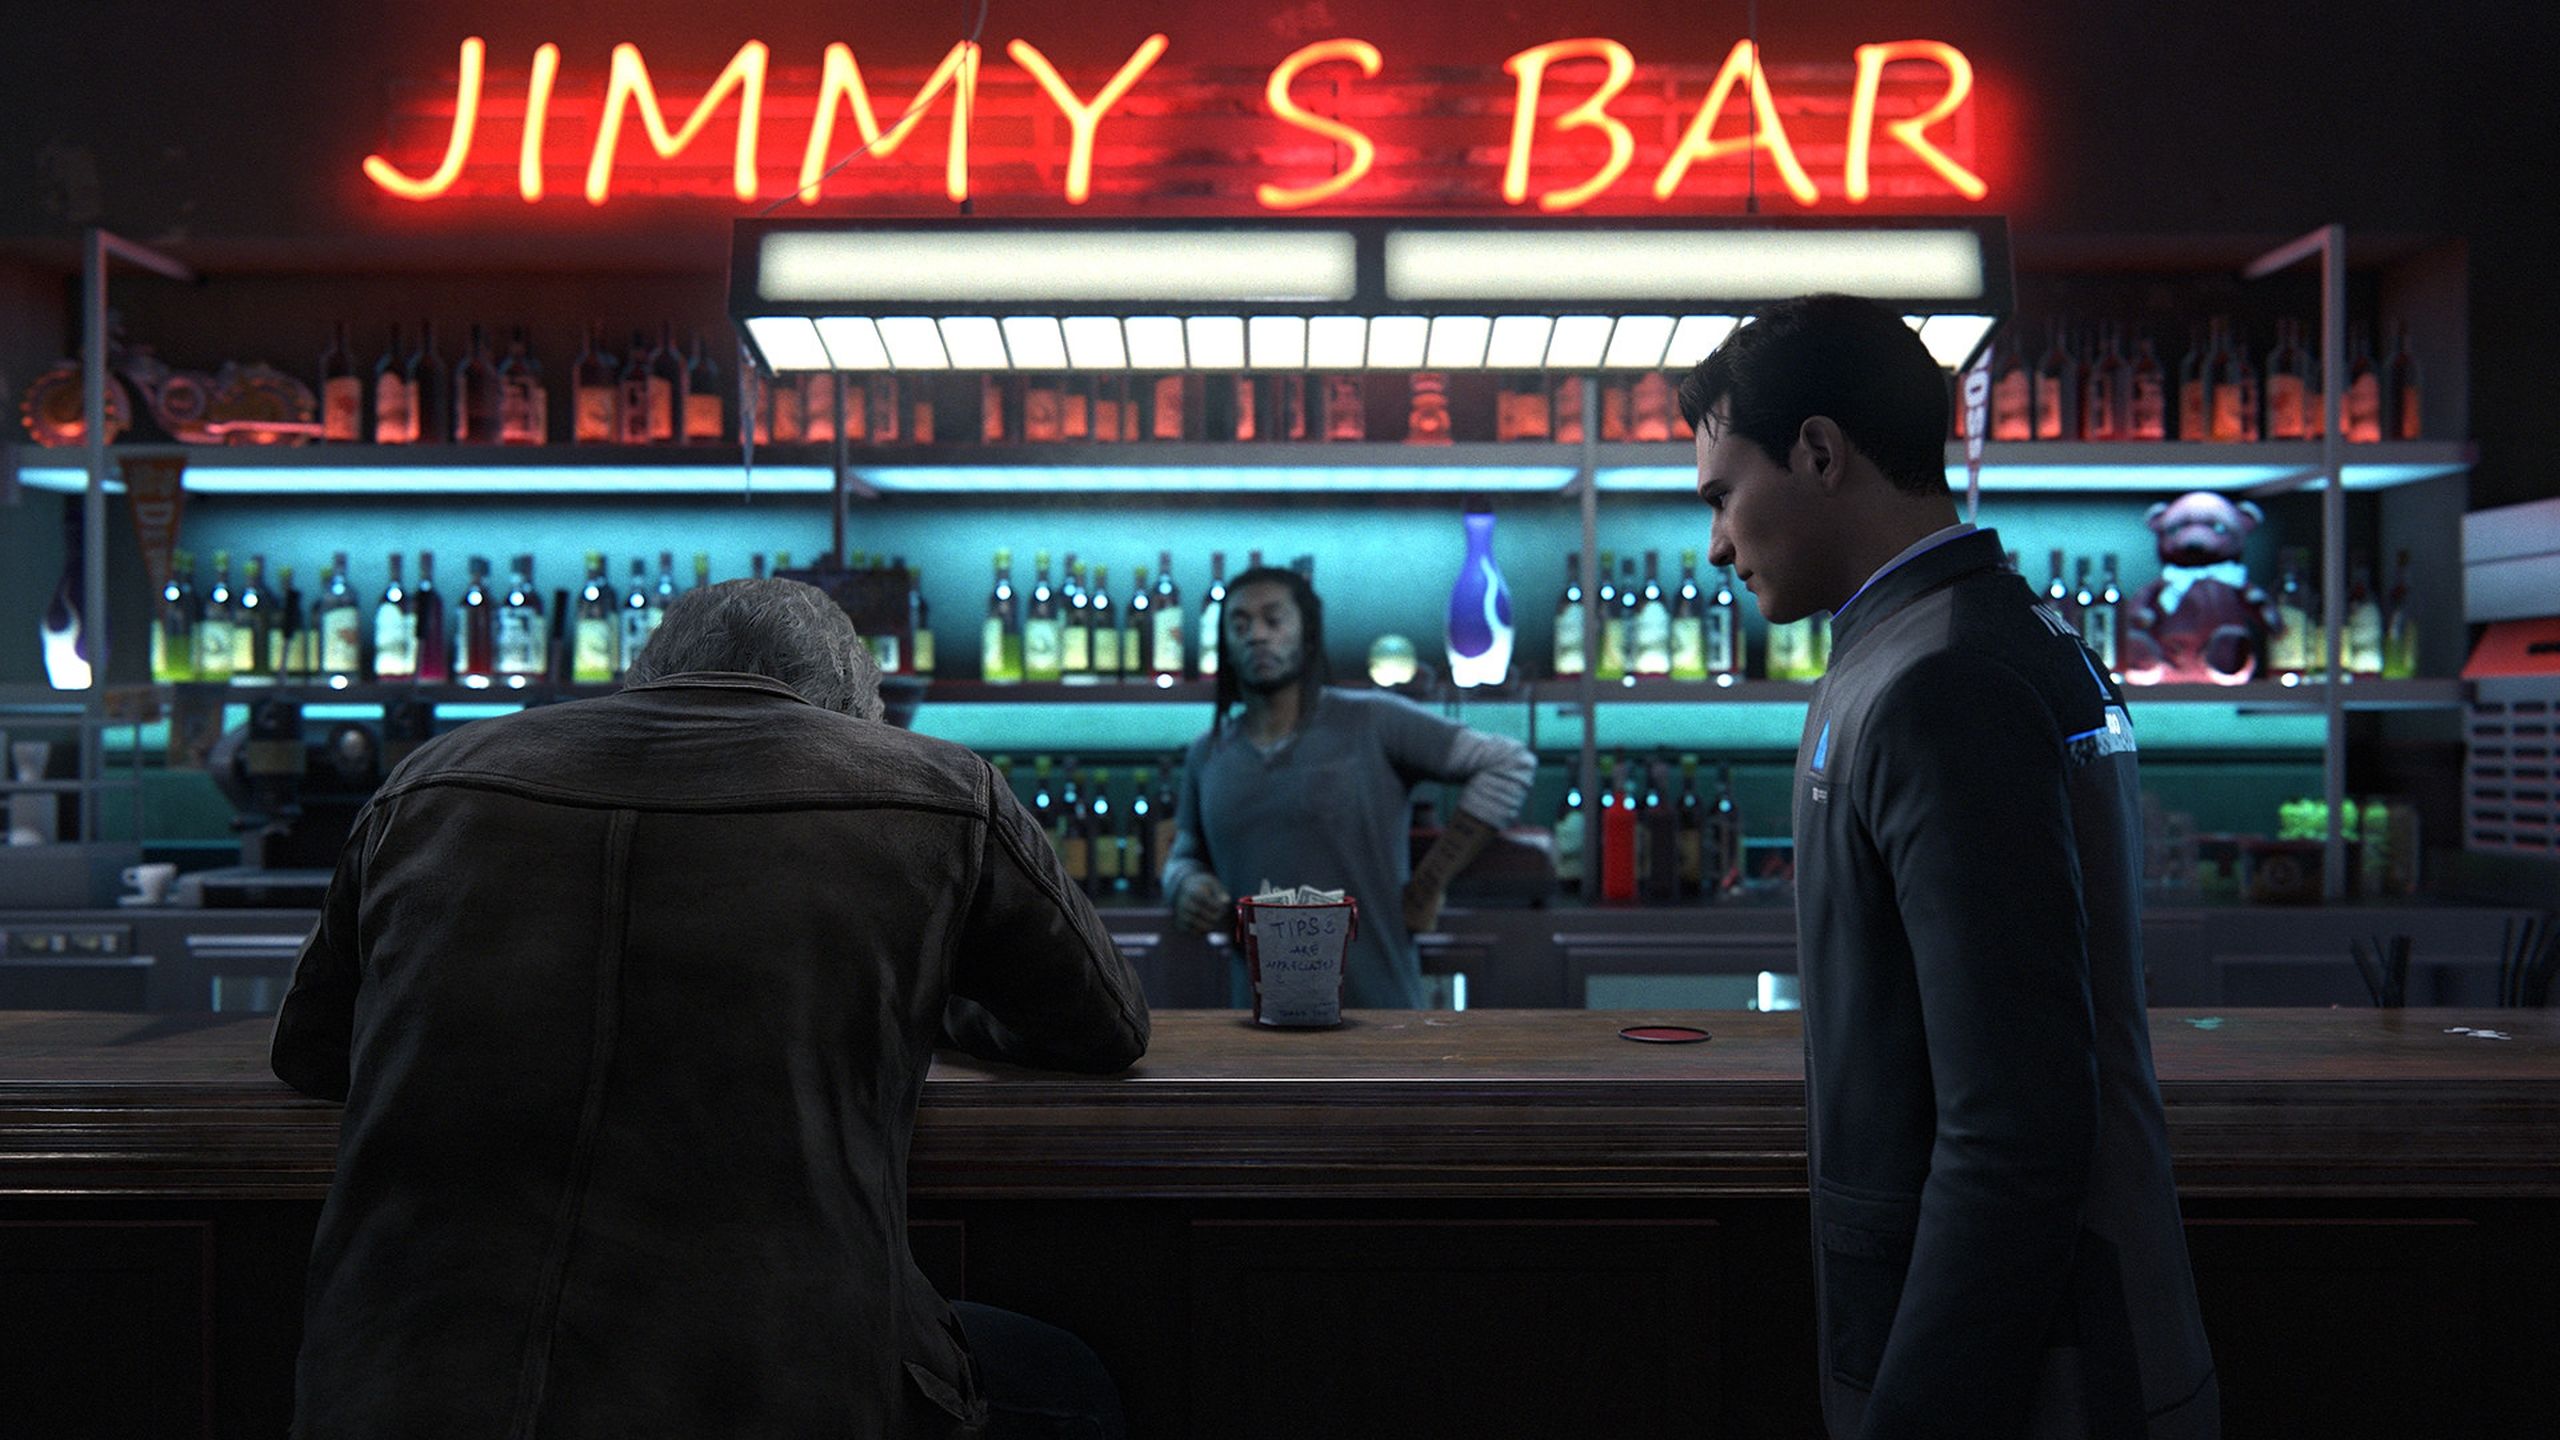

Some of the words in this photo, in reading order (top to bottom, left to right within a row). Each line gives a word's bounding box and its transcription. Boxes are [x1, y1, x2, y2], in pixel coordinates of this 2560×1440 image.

[362, 34, 1168, 205] JIMMY
[1256, 38, 1383, 208] S
[1502, 38, 1988, 210] BAR
